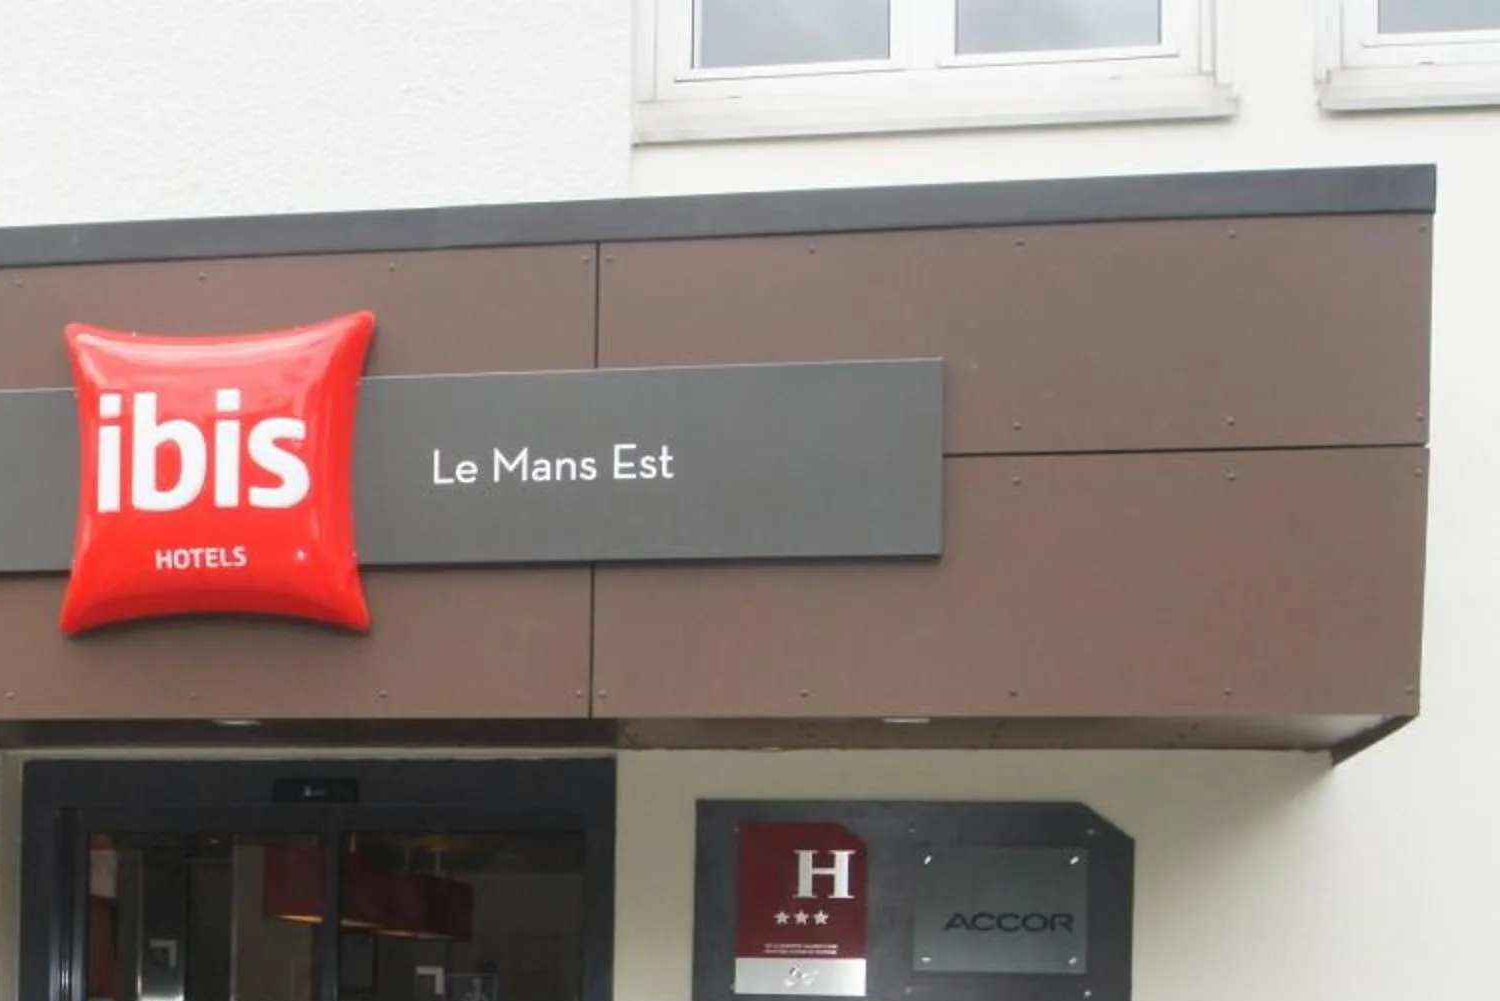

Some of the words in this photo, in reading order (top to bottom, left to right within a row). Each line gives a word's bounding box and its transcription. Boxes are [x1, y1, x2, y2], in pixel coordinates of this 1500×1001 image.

[96, 389, 310, 513] ibis
[432, 449, 478, 486] Le
[493, 447, 598, 484] Mans
[612, 443, 674, 481] Est
[155, 546, 248, 571] HOTELS
[793, 849, 856, 900] H
[942, 912, 1075, 933] ACCOR
